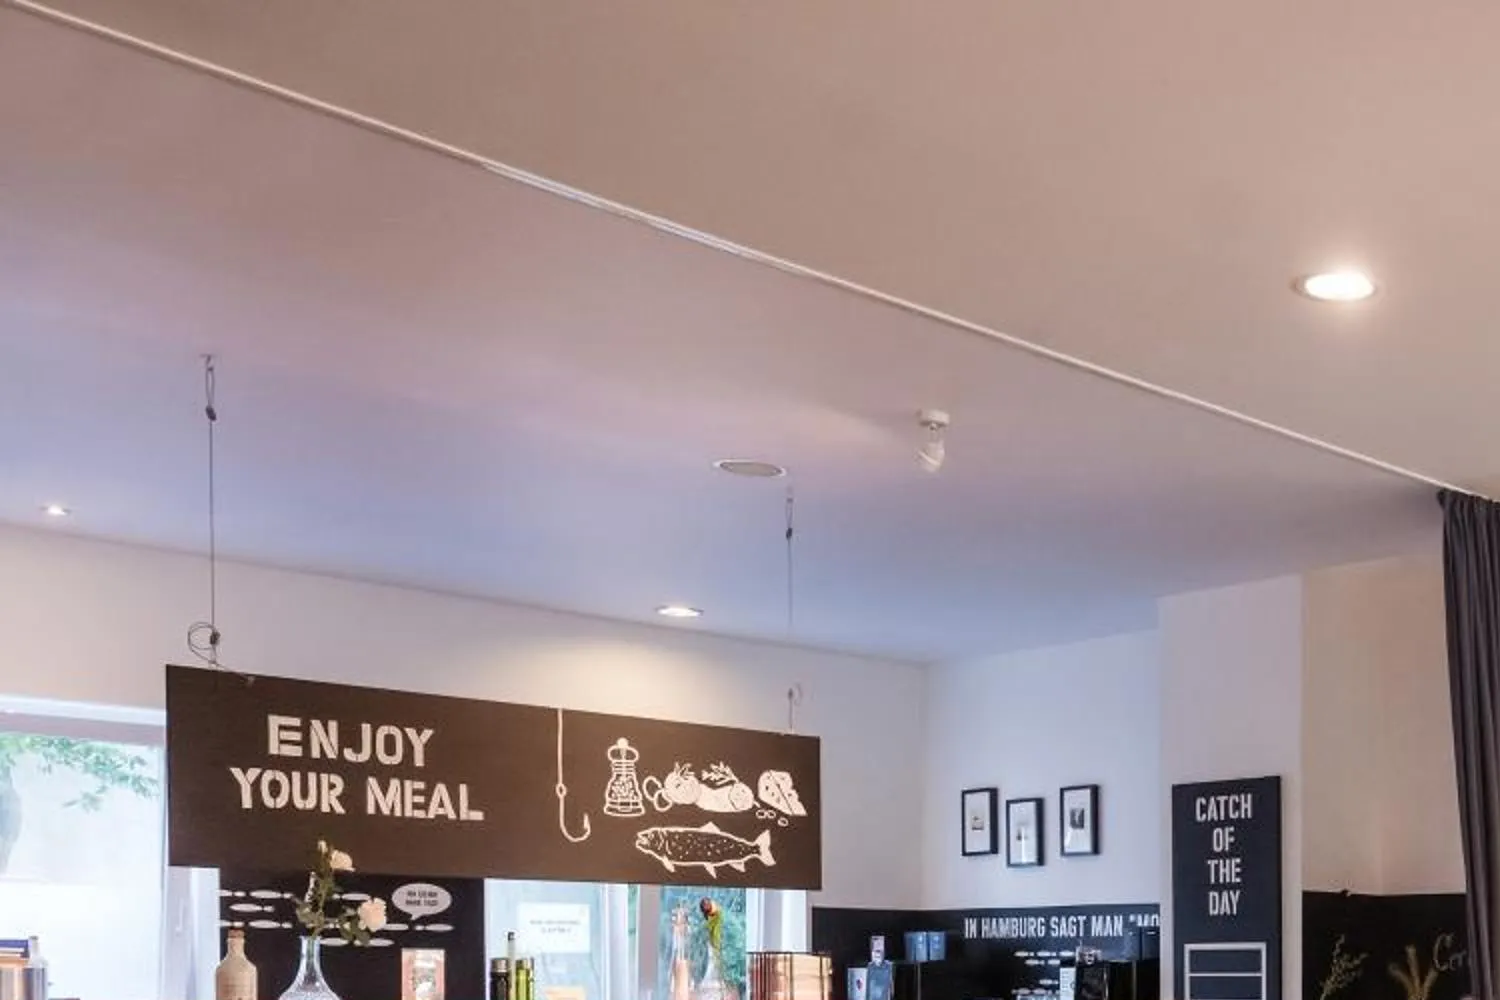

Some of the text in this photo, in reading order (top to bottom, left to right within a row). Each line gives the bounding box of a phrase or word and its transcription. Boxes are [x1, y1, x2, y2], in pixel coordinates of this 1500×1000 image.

[268, 714, 434, 767] ENJOY
[229, 767, 485, 821] YOUR MEAL
[1195, 793, 1252, 822] CATCH
[1213, 826, 1235, 852] OF
[1207, 858, 1242, 884] THE
[1209, 890, 1240, 916] DAY
[964, 917, 977, 938] IN
[981, 915, 1045, 938] HAMBURG
[1049, 914, 1087, 938] SAGT
[1091, 914, 1124, 937] MAN
